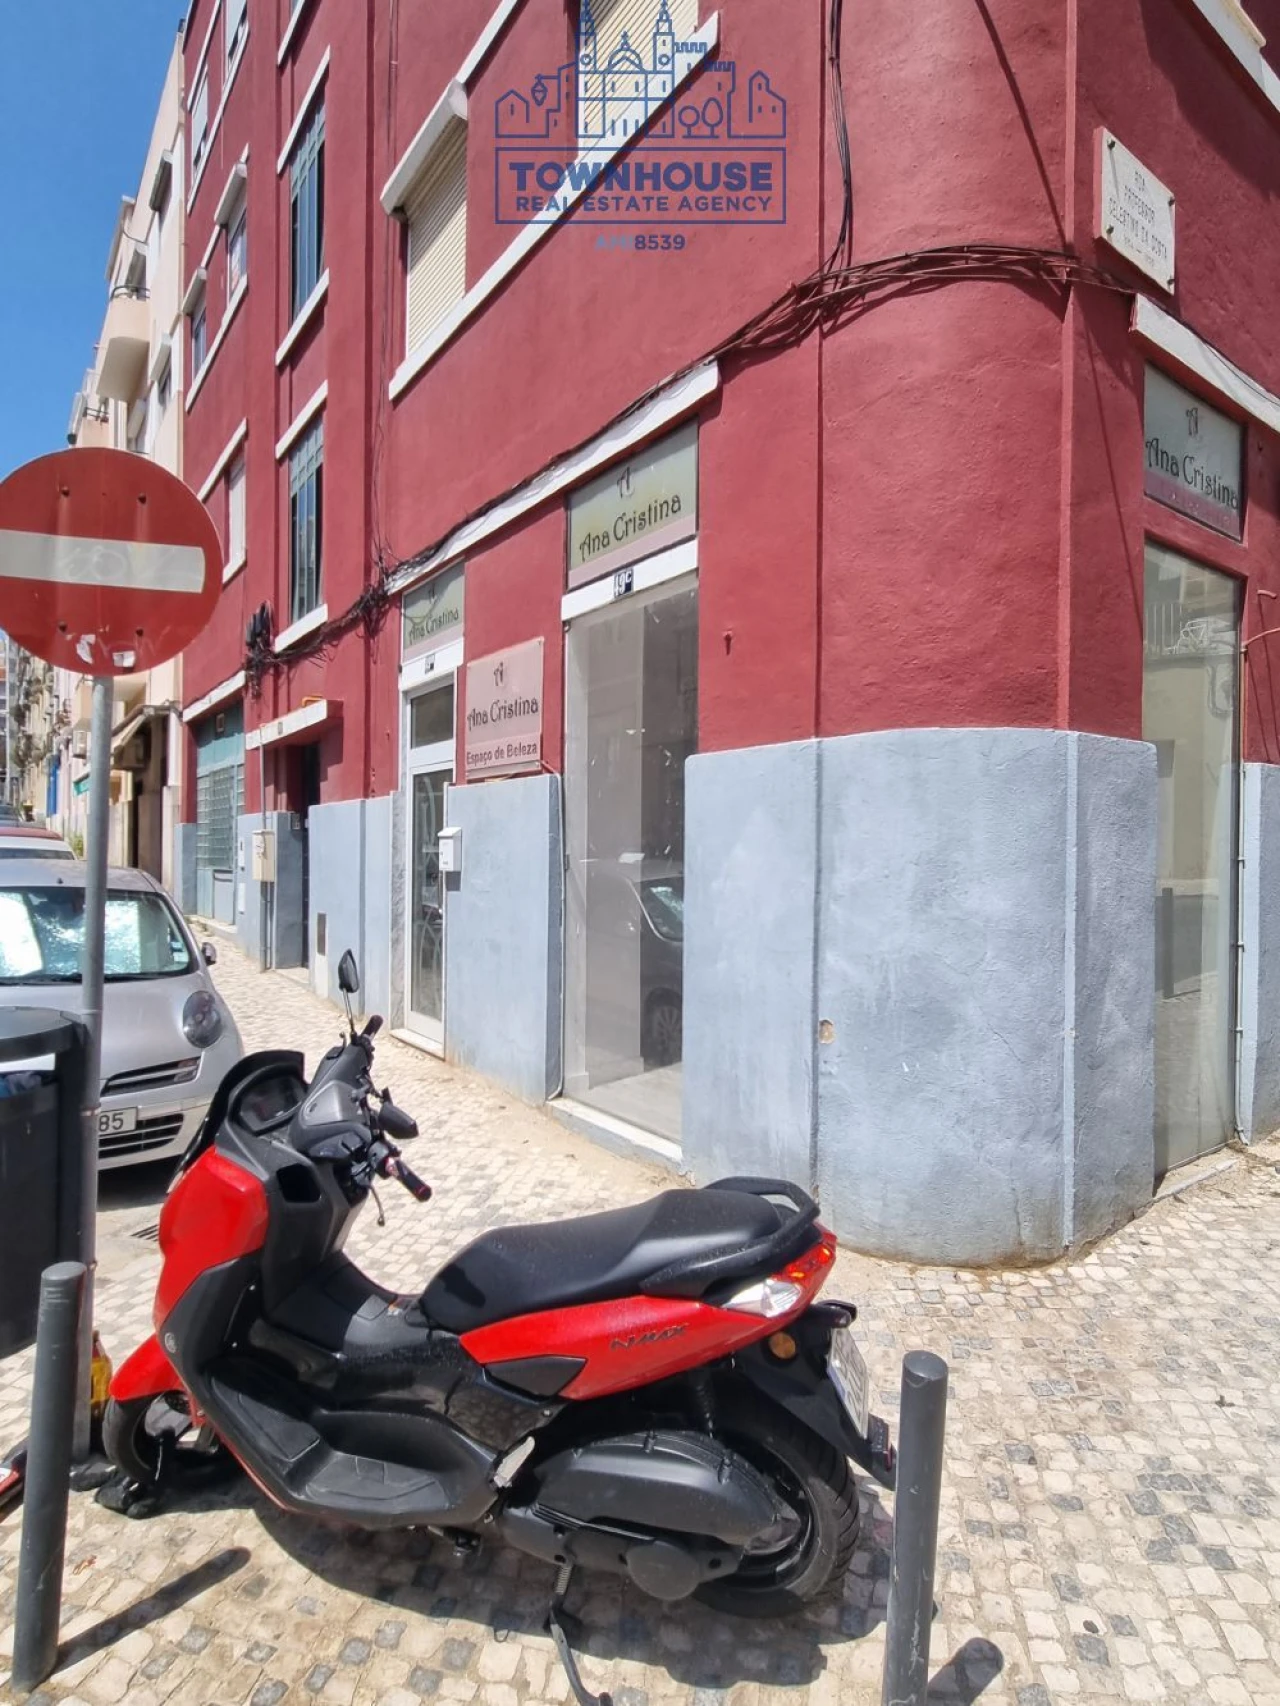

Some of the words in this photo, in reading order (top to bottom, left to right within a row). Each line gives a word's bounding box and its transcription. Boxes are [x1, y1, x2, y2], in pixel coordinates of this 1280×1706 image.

[1145, 437, 1180, 478] Ana
[1183, 454, 1240, 510] Cristina
[579, 532, 610, 562] Ana
[612, 494, 682, 542] Cristina
[467, 706, 489, 732] Ana
[489, 696, 539, 724] Cristina
[466, 747, 493, 766] Espaço
[494, 747, 505, 760] de
[506, 742, 538, 759] Beleza
